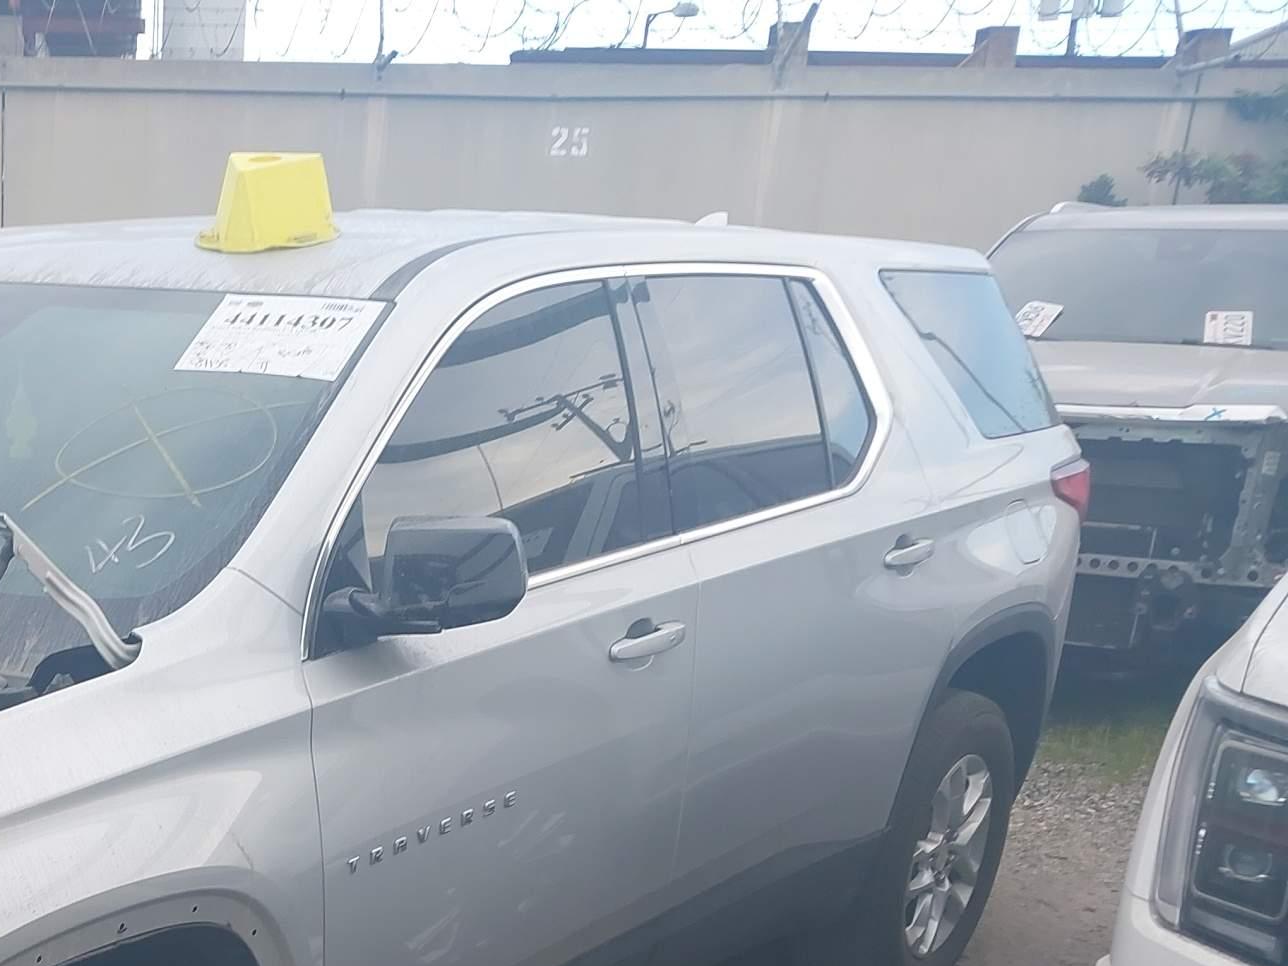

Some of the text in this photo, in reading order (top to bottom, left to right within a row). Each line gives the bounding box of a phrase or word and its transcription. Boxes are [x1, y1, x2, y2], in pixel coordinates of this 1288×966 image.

[550, 126, 590, 156] 25
[225, 311, 354, 332] 44114307
[84, 514, 175, 573] 43
[347, 791, 516, 874] TRAVERSE
